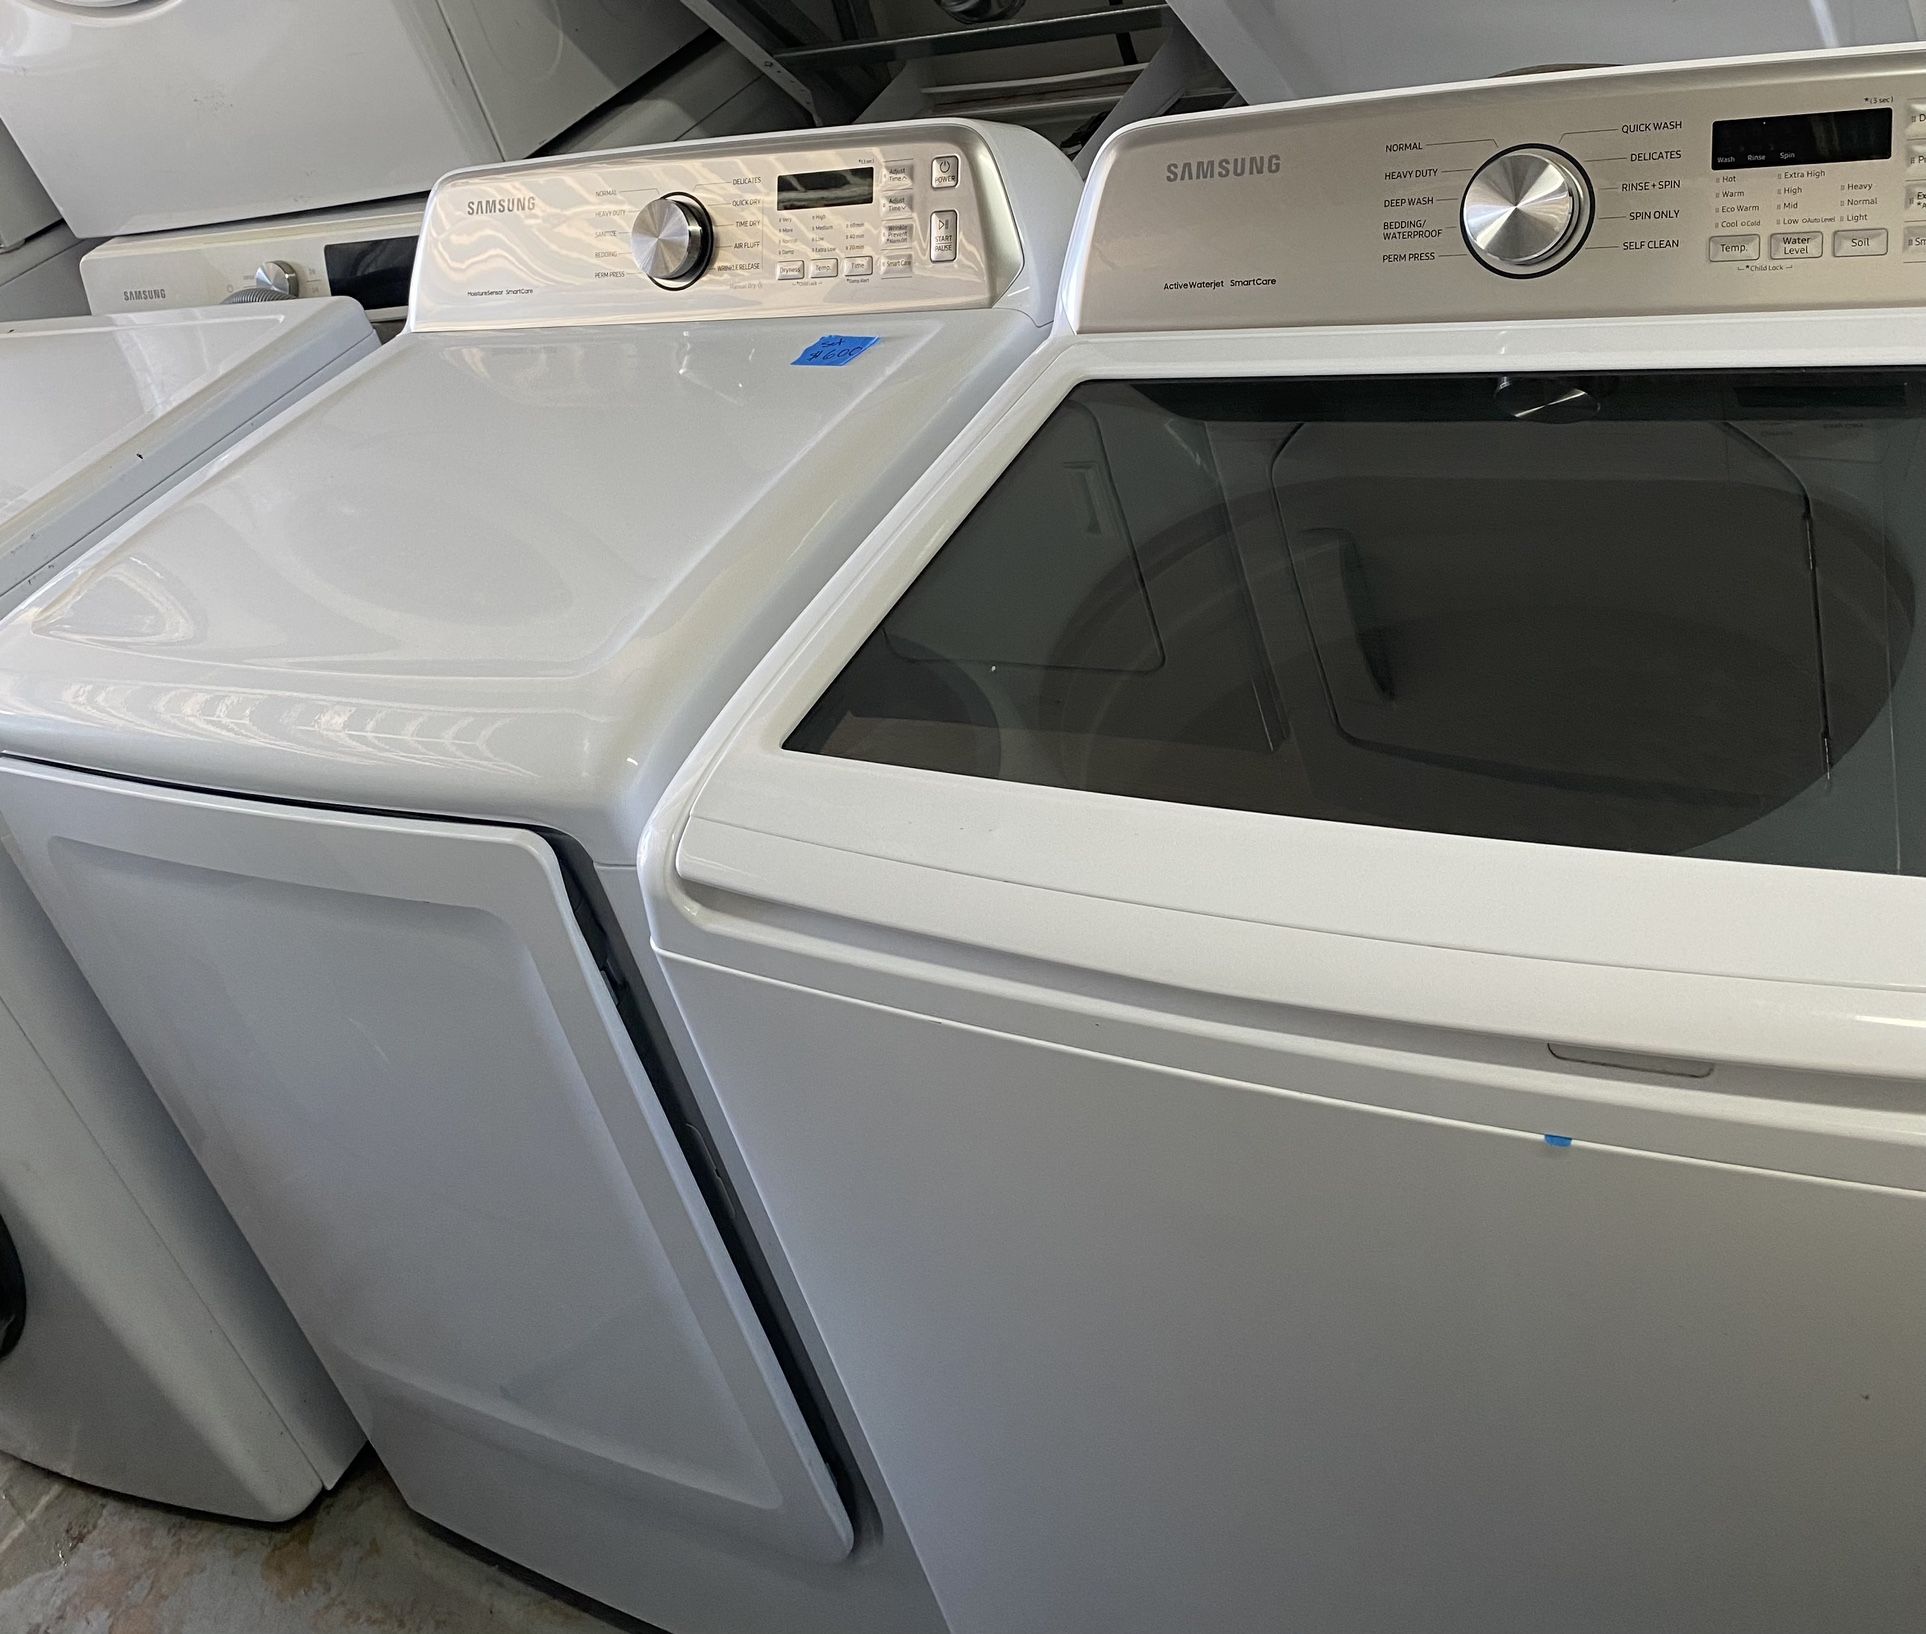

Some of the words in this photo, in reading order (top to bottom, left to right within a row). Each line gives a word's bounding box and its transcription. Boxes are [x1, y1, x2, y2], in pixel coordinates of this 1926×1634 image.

[1621, 123, 1651, 134] QUICK
[1653, 121, 1682, 131] WASH
[1385, 142, 1423, 152] NORMAL
[1630, 149, 1682, 162] DELICATES
[1166, 154, 1281, 183] SAMSUNG
[1384, 170, 1413, 180] HEAVY
[1415, 168, 1438, 178] DUTY
[1722, 175, 1736, 183] Hot
[1806, 170, 1826, 179] High
[732, 177, 762, 186] DELICATES
[1621, 182, 1650, 192] RINSE
[1658, 180, 1681, 189] SPIN
[1783, 188, 1803, 196] High
[1847, 183, 1873, 192] Heavy
[467, 196, 536, 216] SAMSUNG
[1383, 199, 1406, 208] DEEP
[1407, 196, 1434, 206] WASH
[1847, 197, 1878, 206] Normal
[1629, 211, 1652, 220] SPIN
[1653, 210, 1680, 220] ONLY
[1846, 214, 1868, 222] Light
[1383, 219, 1426, 230] BEDDING/
[1721, 220, 1738, 228] Cool
[1783, 217, 1799, 225] Low
[1382, 229, 1443, 241] WATERPROOF
[1623, 241, 1645, 250] SELF
[1647, 240, 1679, 250] CLEAN
[1783, 236, 1811, 246] Water
[1851, 238, 1870, 247] Soil
[1720, 243, 1748, 254] Temp.
[1784, 246, 1809, 255] Level
[1382, 254, 1407, 263] PERM
[1408, 252, 1436, 261] PRESS
[739, 262, 760, 270] RELEASE
[780, 266, 800, 274] Dryness
[1230, 277, 1277, 288] SmartCare
[123, 288, 166, 301] SAMSUNG
